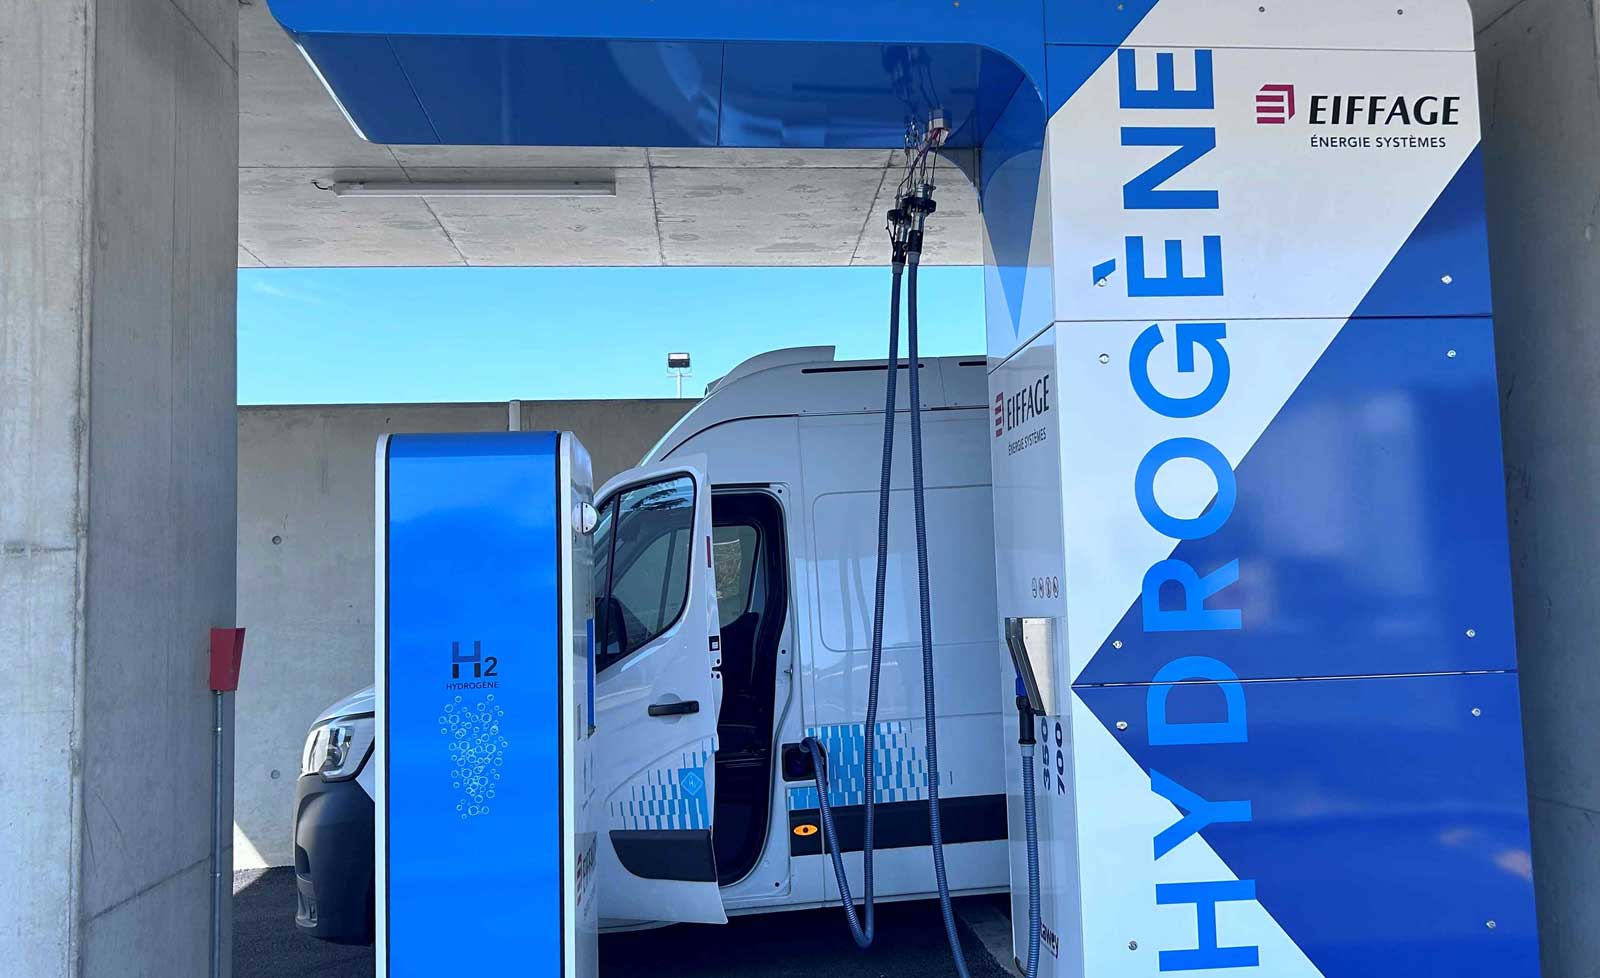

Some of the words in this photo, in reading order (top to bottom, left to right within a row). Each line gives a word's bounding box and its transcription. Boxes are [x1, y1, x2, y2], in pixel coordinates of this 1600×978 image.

[1309, 95, 1460, 126] EIFFAGE
[1310, 134, 1370, 148] ÉNERGIE
[1375, 134, 1447, 148] SYSTÈMES
[1007, 374, 1050, 431] EIFFAGE
[1093, 48, 1259, 972] HYDROGÈNE
[452, 640, 498, 679] H2
[1041, 717, 1051, 791] 350
[1055, 722, 1066, 796] 700
